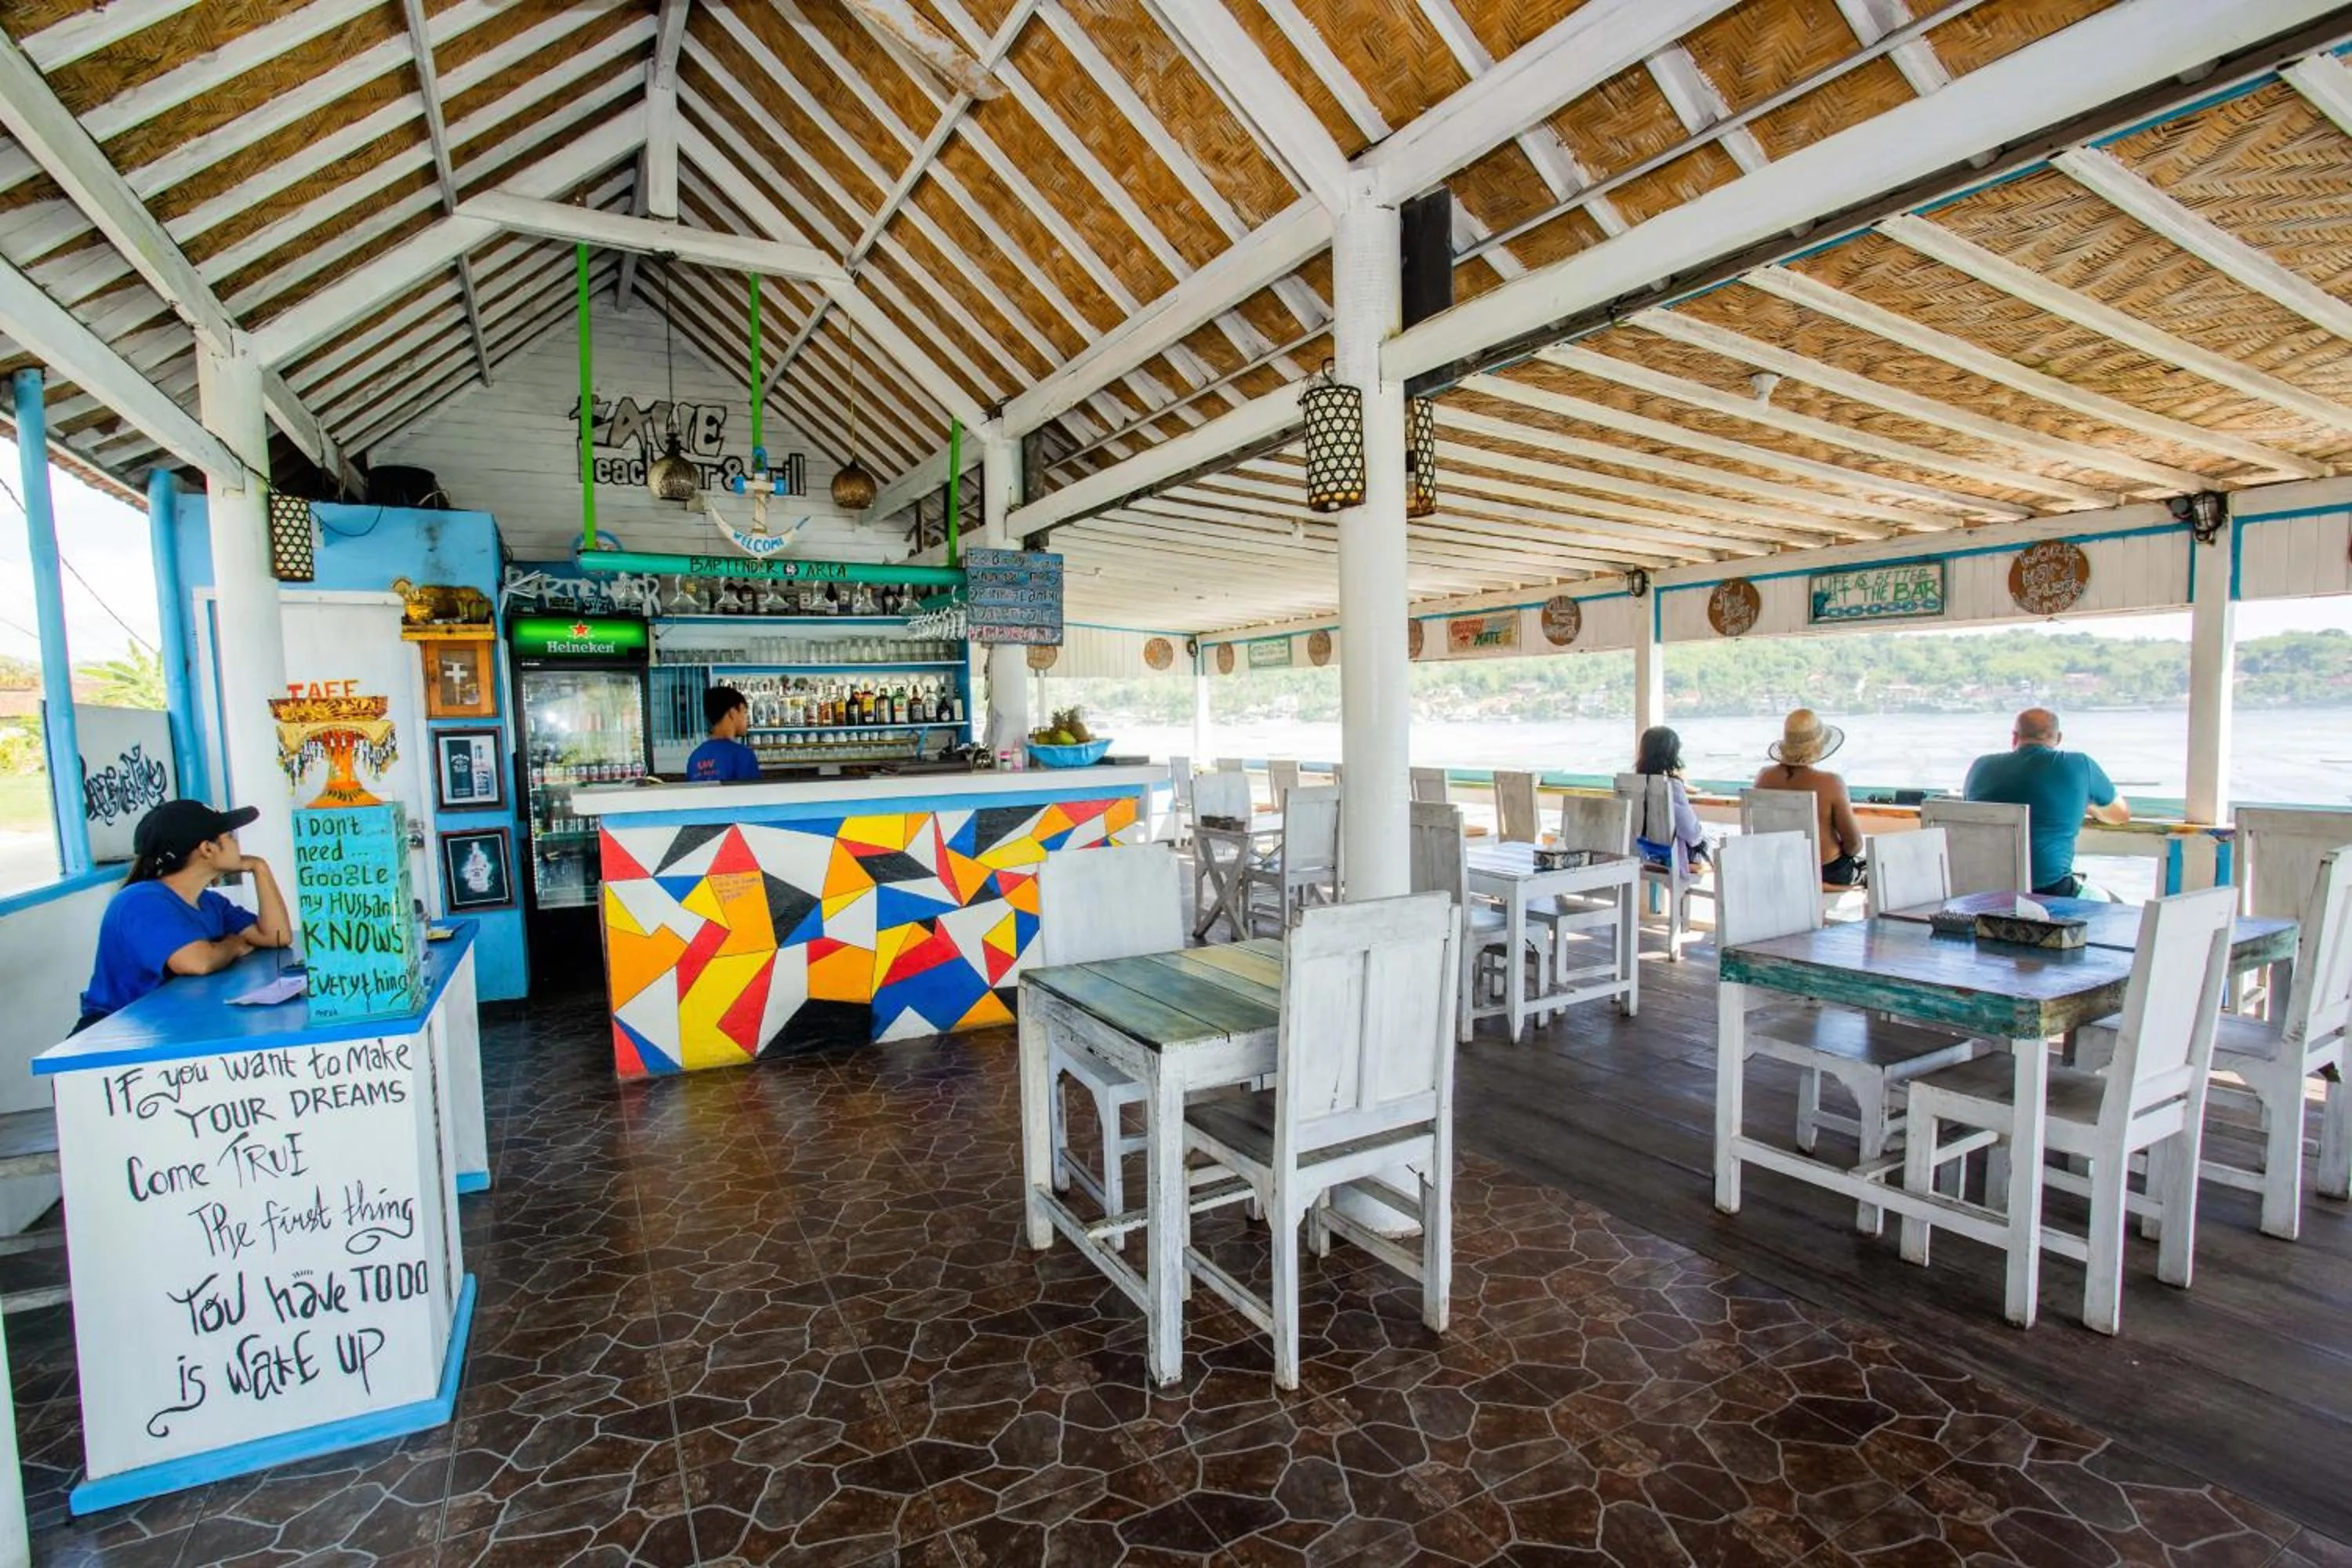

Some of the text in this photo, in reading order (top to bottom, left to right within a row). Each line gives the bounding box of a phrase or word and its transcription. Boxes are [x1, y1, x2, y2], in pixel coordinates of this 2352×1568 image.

[578, 437, 654, 486] eac
[1893, 579, 1941, 601] BAR
[546, 641, 615, 653] Heineken
[297, 840, 343, 862] need
[175, 1080, 407, 1138] YOUR DREAMS
[261, 1185, 332, 1254] first
[343, 1179, 414, 1254] thing
[265, 1271, 350, 1323] have
